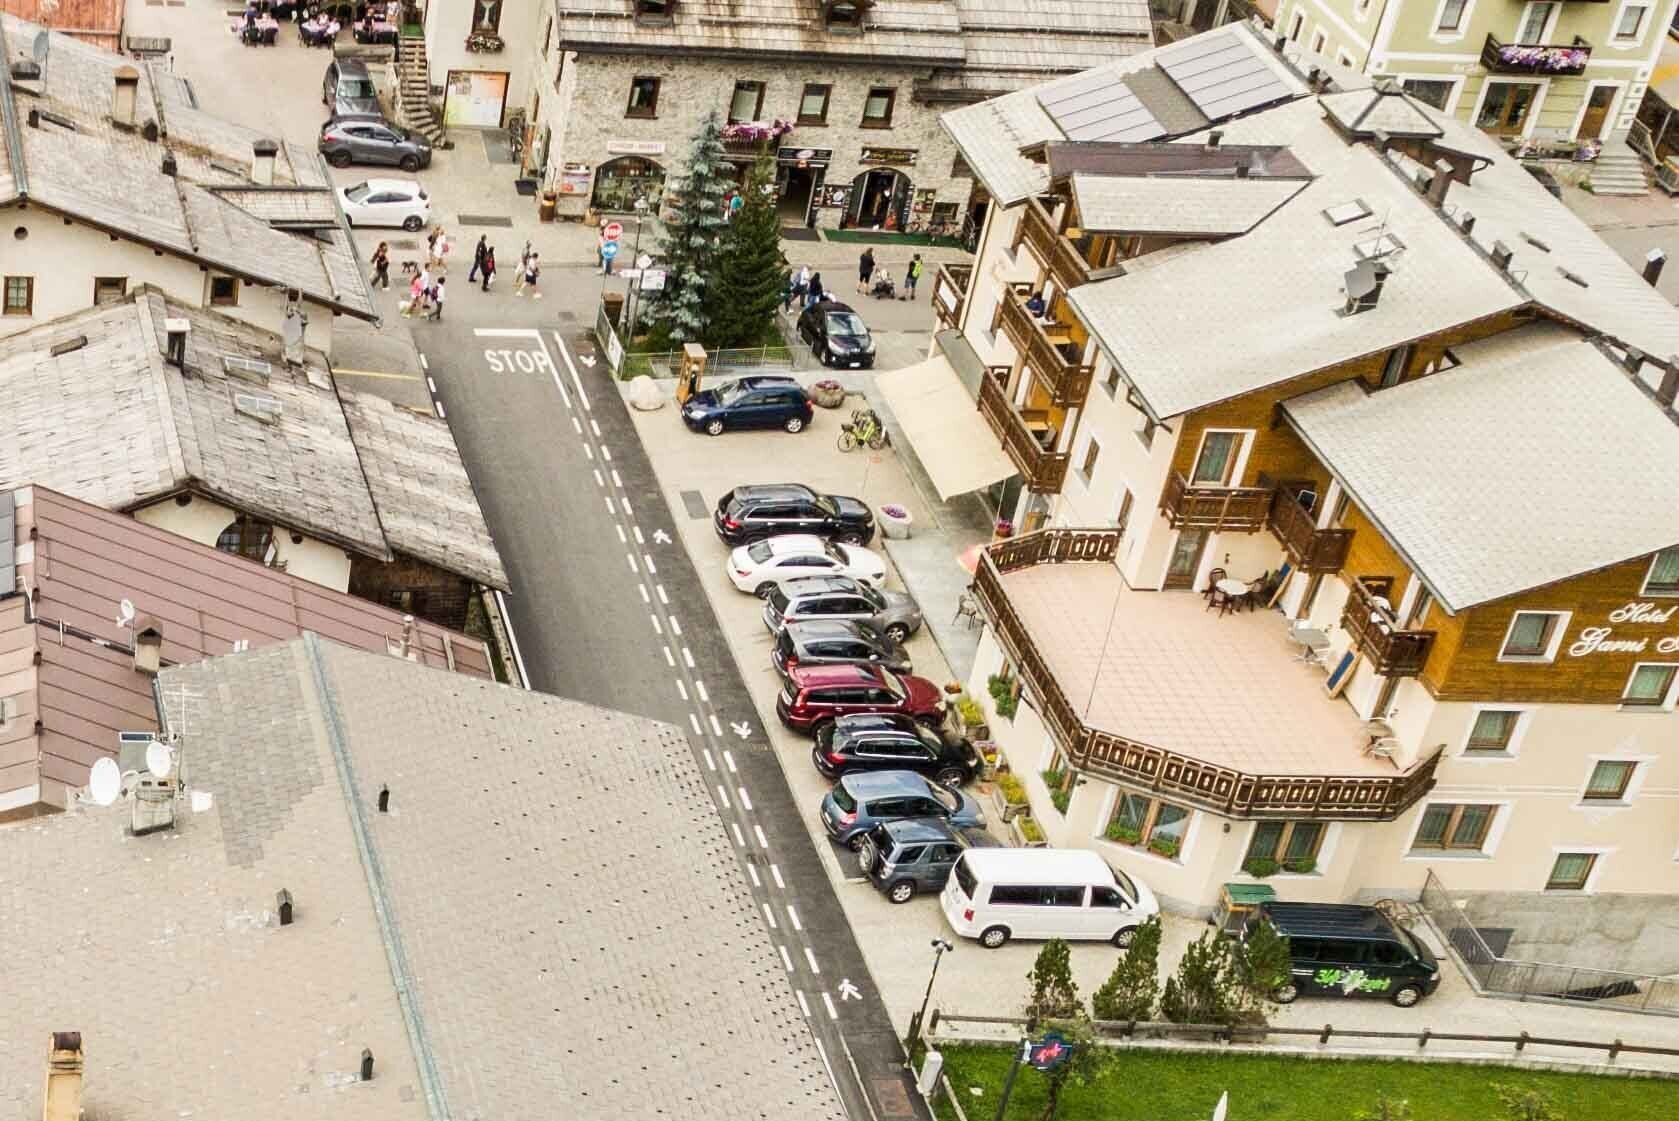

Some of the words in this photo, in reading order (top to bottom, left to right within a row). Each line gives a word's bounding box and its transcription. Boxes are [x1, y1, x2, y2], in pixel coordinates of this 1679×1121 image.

[484, 349, 550, 373] STOP
[1609, 602, 1678, 623] Hotel
[1569, 627, 1649, 657] Garni
